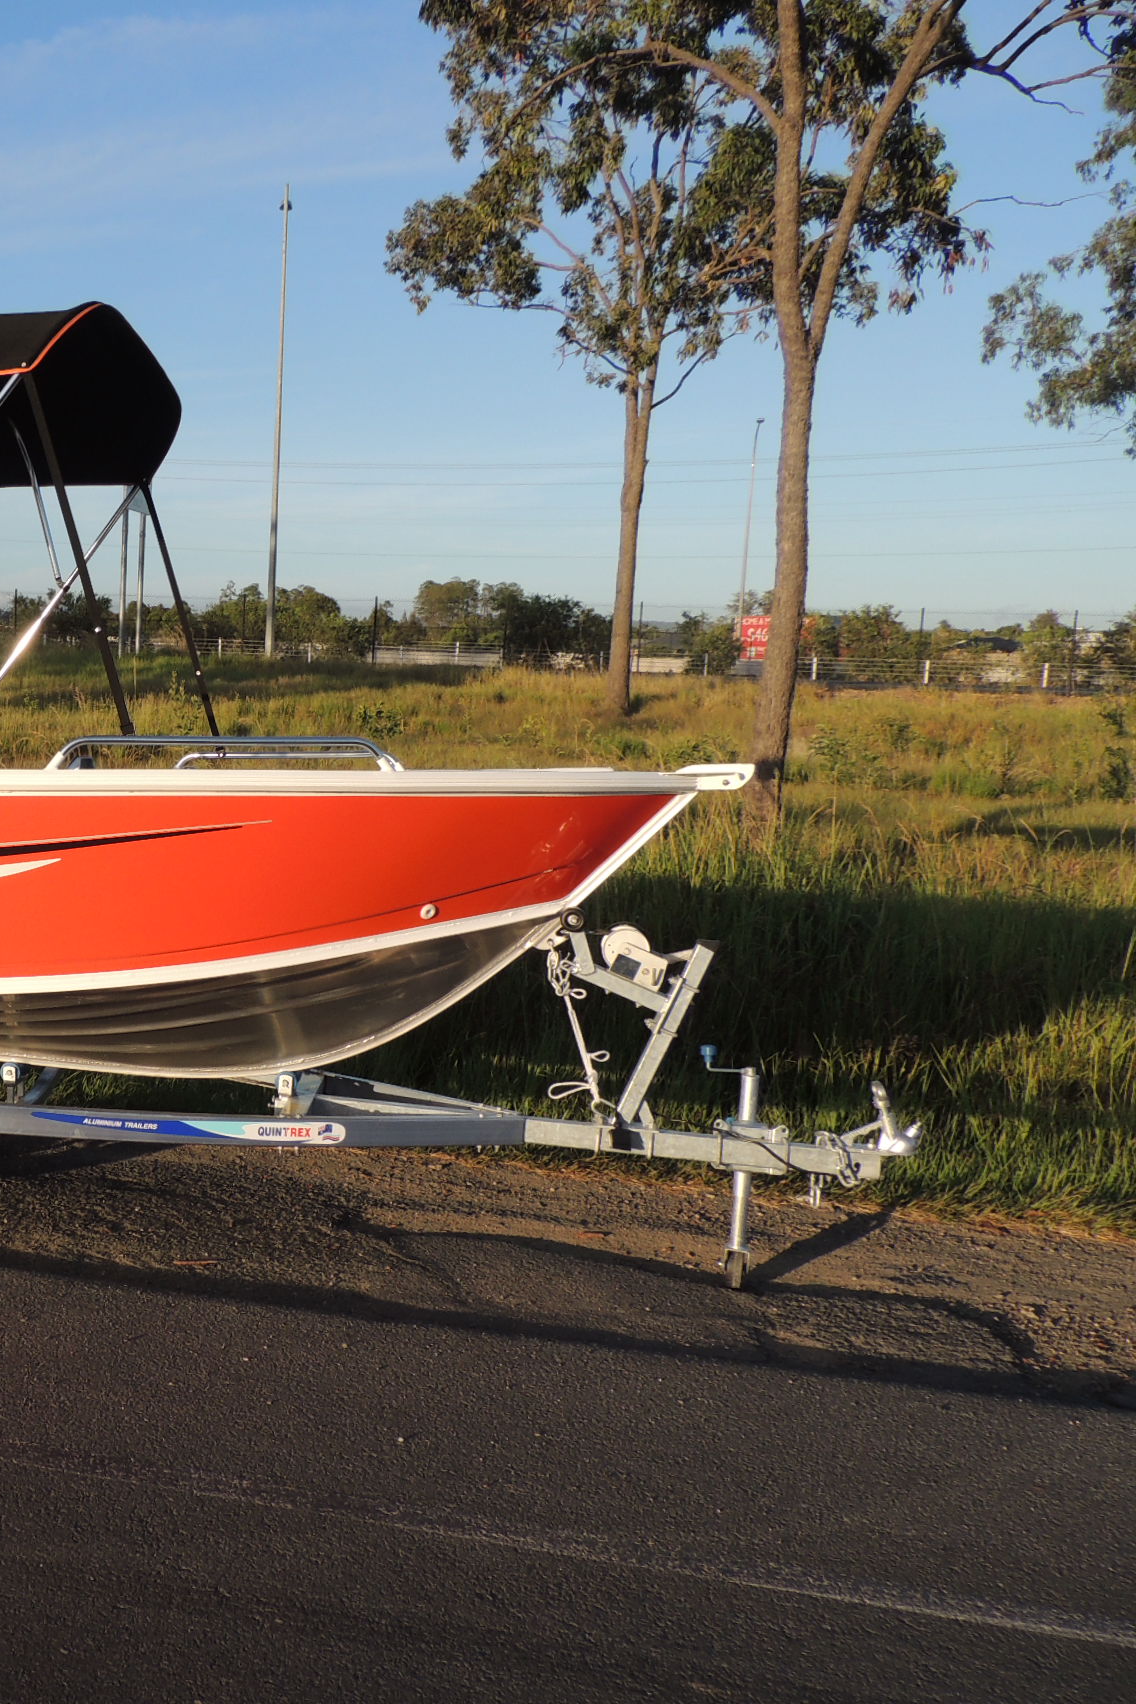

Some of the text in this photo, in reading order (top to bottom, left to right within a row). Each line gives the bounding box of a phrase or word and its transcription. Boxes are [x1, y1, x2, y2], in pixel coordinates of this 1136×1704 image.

[82, 1117, 159, 1130] ALUMINIUM TRAILERS
[257, 1126, 312, 1138] QUINTREX
